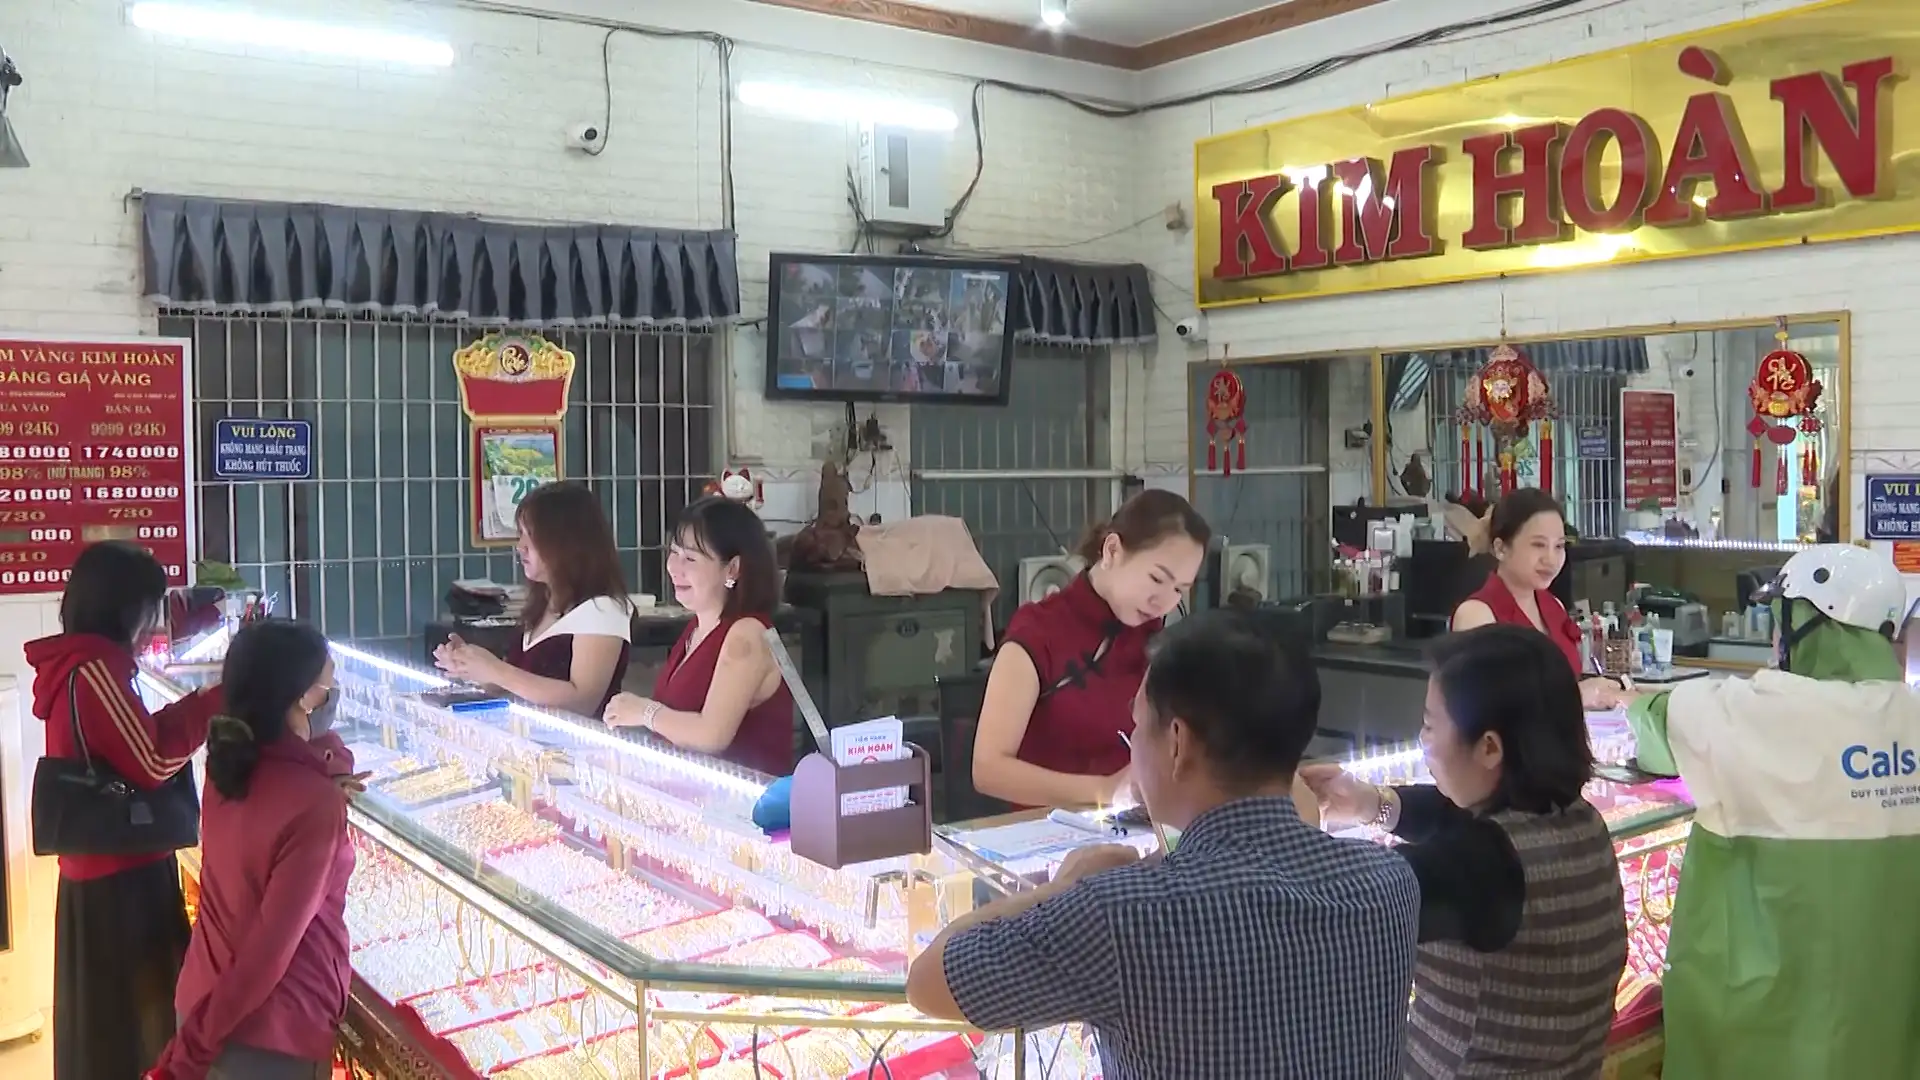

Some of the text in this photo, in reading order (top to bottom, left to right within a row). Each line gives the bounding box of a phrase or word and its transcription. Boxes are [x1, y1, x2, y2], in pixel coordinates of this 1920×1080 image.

[1211, 46, 1898, 280] KIM HOÀN
[20, 344, 75, 363] VÀNG
[82, 351, 116, 364] KIM
[123, 349, 176, 366] HOÀN
[97, 369, 152, 386] VÀNG
[22, 401, 50, 413] VÀO
[135, 404, 152, 414] RA
[19, 421, 60, 437] (24K)
[128, 422, 166, 438] (24K)
[231, 424, 296, 439] VUI LÒNG
[83, 446, 179, 459] 1740000
[220, 440, 244, 454] KHÔNG
[245, 443, 264, 455] MANG
[285, 444, 306, 456] TRANG
[110, 465, 150, 479] 98%
[224, 457, 302, 473] KHÔNG HÚT THUỐC
[83, 486, 179, 499] 1680000
[1883, 483, 1910, 496] VUI
[108, 507, 153, 519] 730
[1877, 517, 1909, 532] KHÔNG
[31, 528, 72, 541] 000
[139, 526, 178, 538] 000
[848, 745, 865, 756] KIM
